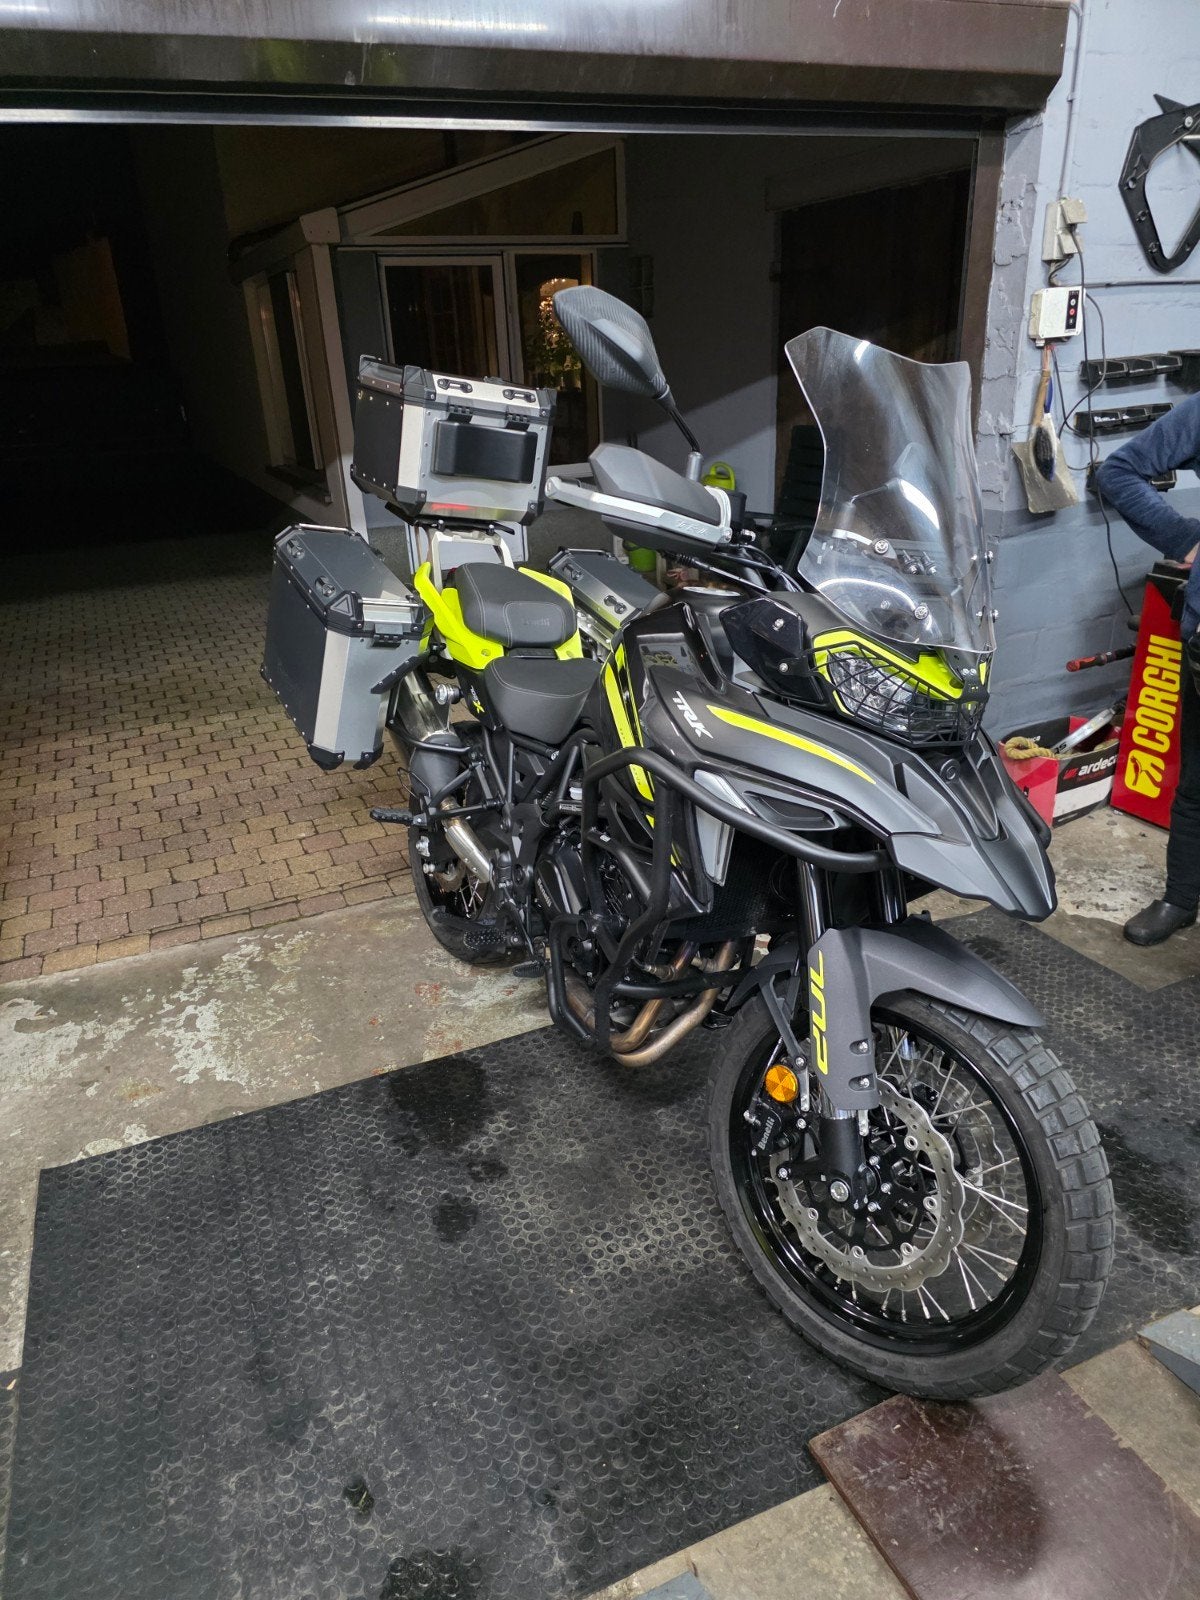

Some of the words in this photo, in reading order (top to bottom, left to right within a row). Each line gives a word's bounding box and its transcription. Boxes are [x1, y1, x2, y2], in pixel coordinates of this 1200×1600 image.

[672, 690, 714, 738] TRK
[1132, 634, 1182, 754] CORGHI
[1078, 754, 1118, 776] ardec
[758, 1116, 775, 1150] Benelli
